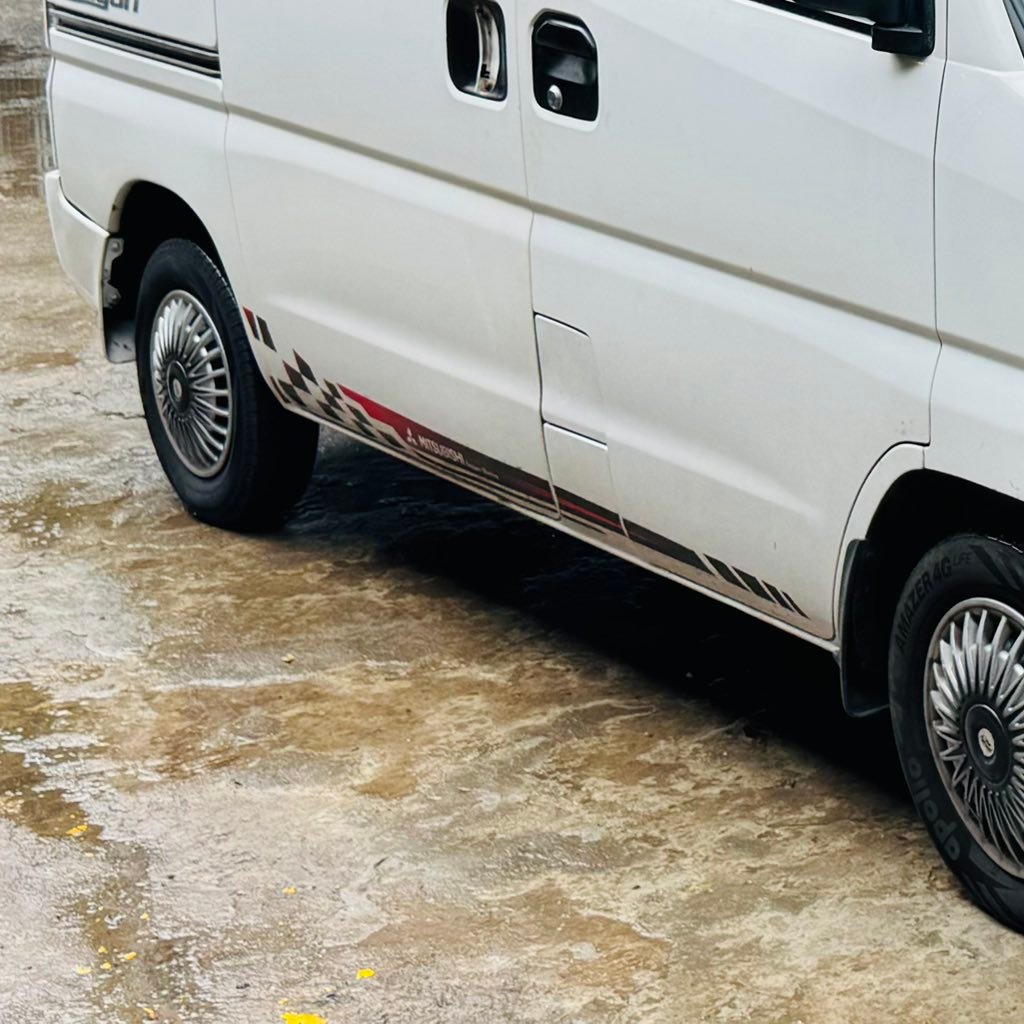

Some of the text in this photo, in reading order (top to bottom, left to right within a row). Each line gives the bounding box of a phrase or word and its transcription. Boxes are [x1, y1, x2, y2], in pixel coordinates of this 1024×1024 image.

[418, 434, 465, 465] MITSUBISHI
[895, 571, 933, 655] AMAZER
[933, 556, 953, 585] 4G
[909, 757, 961, 862] apollo
